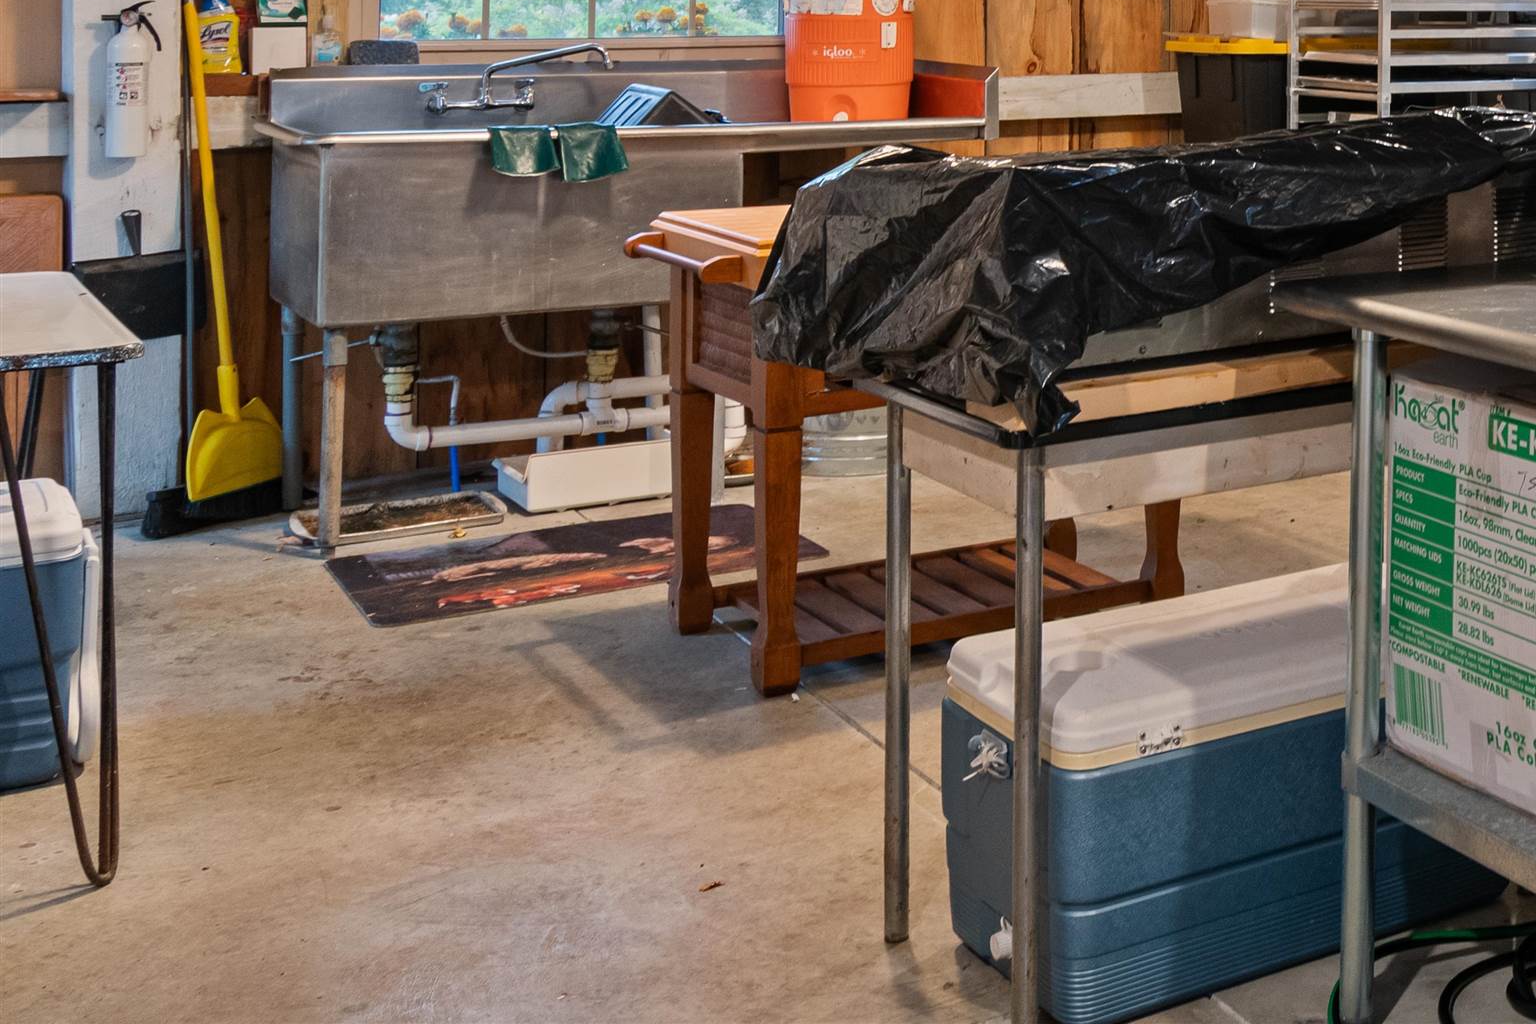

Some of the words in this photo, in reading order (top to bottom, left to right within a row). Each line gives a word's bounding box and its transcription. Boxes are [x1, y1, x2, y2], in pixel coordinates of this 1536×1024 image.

[200, 24, 229, 39] Lysol
[823, 45, 854, 60] igloo
[1433, 430, 1459, 450] earth
[1394, 442, 1411, 457] 16oz
[1411, 448, 1457, 474] Eco-Friendly
[1459, 463, 1474, 478] PLA
[1475, 467, 1493, 484] Cup
[1395, 464, 1425, 484] PRODUCT
[1395, 489, 1414, 505] SPECS
[1458, 483, 1510, 513] Eco-Friendly
[1512, 499, 1529, 517] PLA
[1394, 512, 1427, 534] QUANTITY
[1482, 517, 1514, 541] 98mm,
[1393, 537, 1428, 559] MATCHING
[1428, 550, 1443, 565] LIDS
[1457, 535, 1493, 559] 1000pcs
[1493, 547, 1528, 574] (20x50)
[1392, 569, 1415, 588] GROSS
[1414, 578, 1441, 598] WEIGHT
[1392, 594, 1404, 608] NET
[1404, 598, 1431, 619] WEIGHT
[1458, 596, 1482, 615] 30.99
[1482, 604, 1496, 621] lbs
[1481, 629, 1495, 647] lbs
[1486, 730, 1513, 756] PLA
[1495, 721, 1527, 747] 16oz
